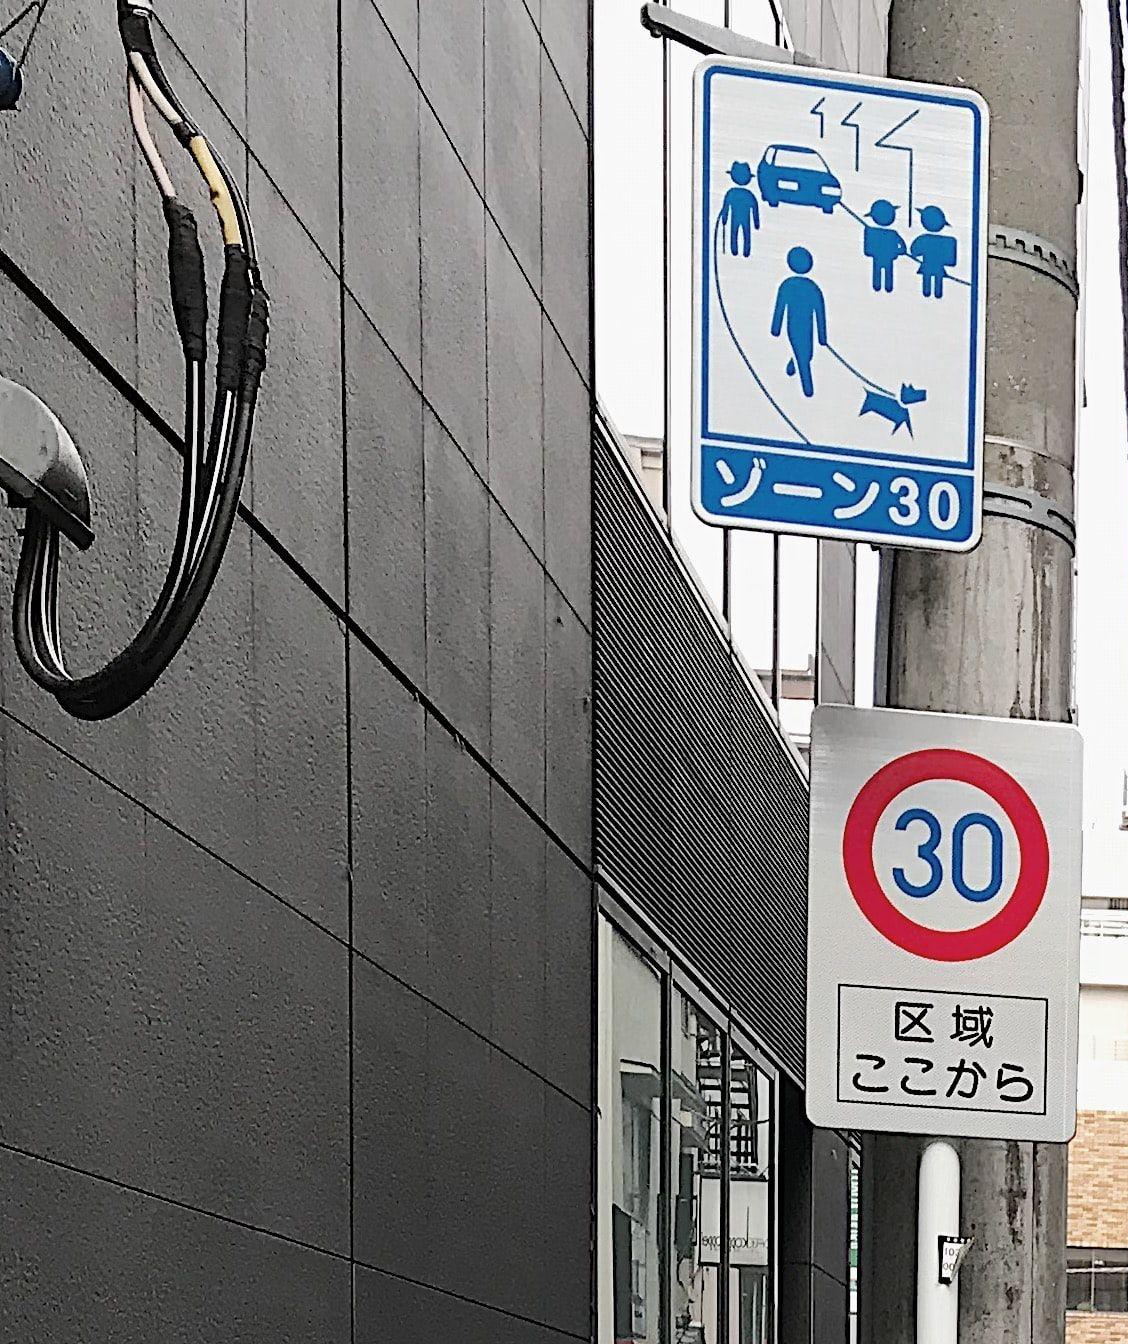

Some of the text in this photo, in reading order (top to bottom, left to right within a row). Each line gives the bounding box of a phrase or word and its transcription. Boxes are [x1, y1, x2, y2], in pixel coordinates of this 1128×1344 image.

[715, 456, 962, 532] ゾーン30
[892, 807, 1004, 903] 30
[894, 1001, 994, 1049] 区域
[852, 1053, 1034, 1102] ここから
